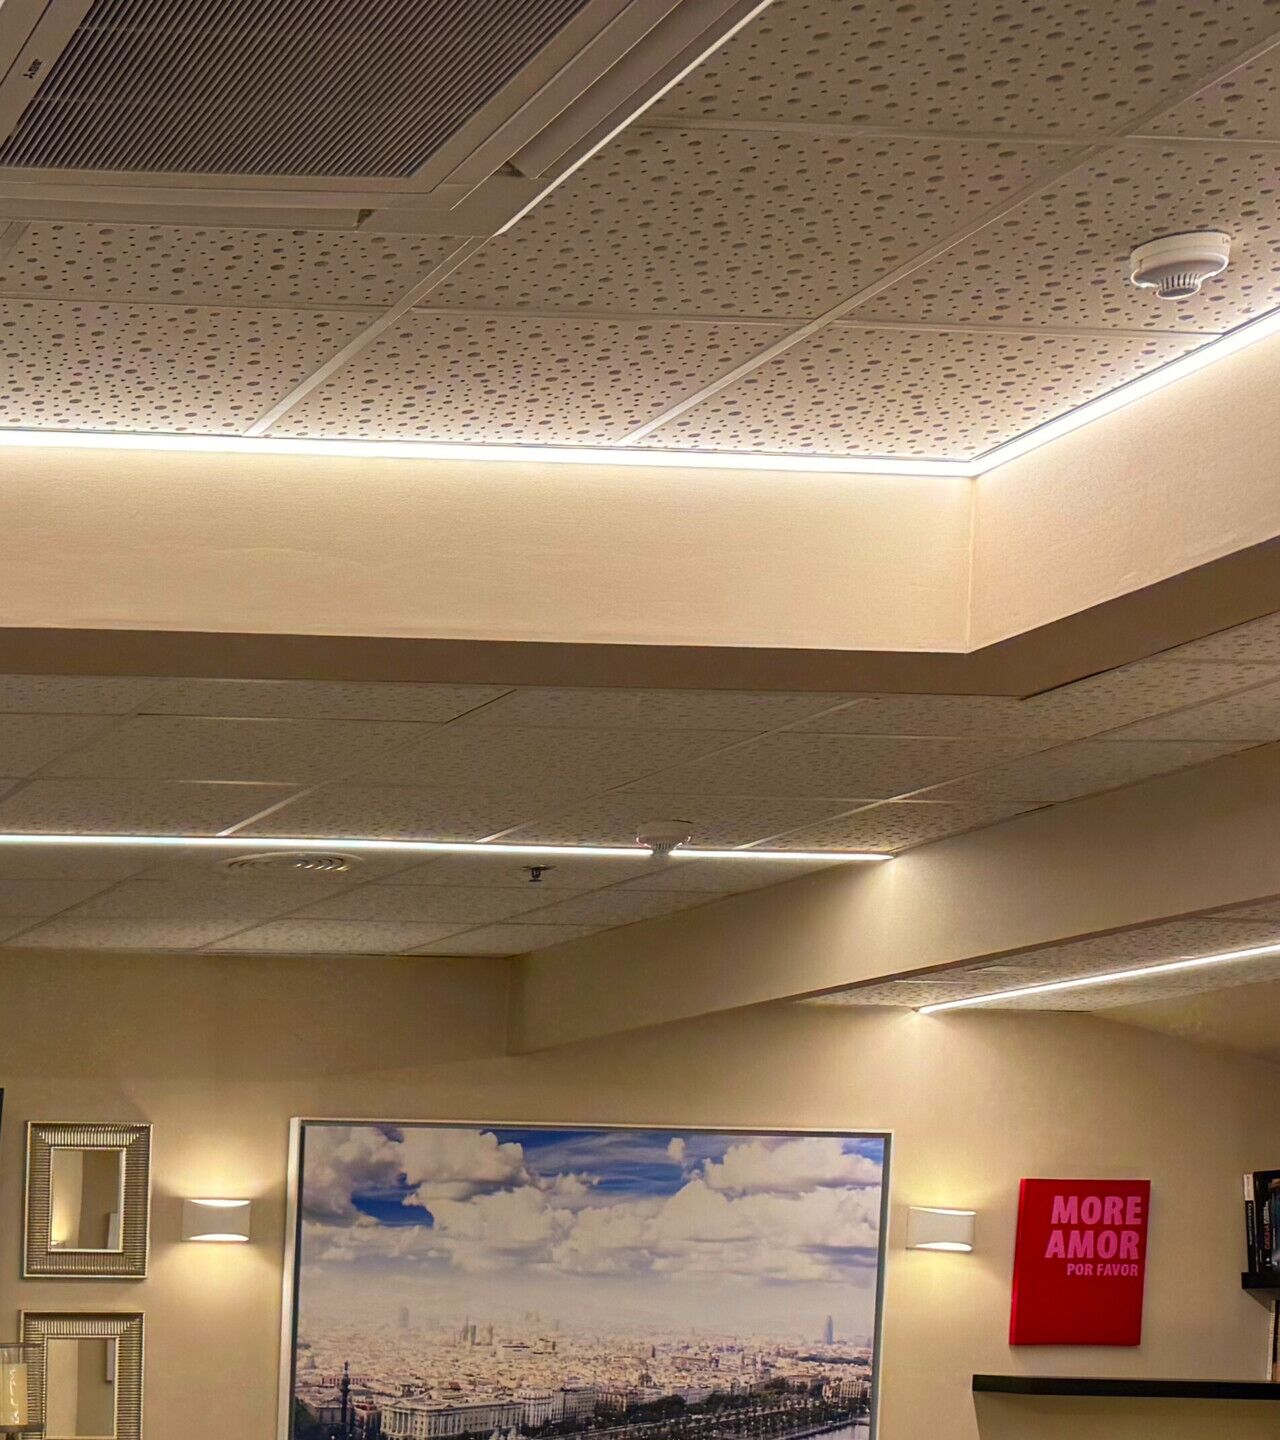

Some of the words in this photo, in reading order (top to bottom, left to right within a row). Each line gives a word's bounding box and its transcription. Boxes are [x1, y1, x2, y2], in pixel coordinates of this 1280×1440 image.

[1051, 1195, 1142, 1225] MORE
[1044, 1230, 1140, 1260] AMOR
[1066, 1263, 1093, 1276] POR
[1096, 1263, 1139, 1277] FAVOR
